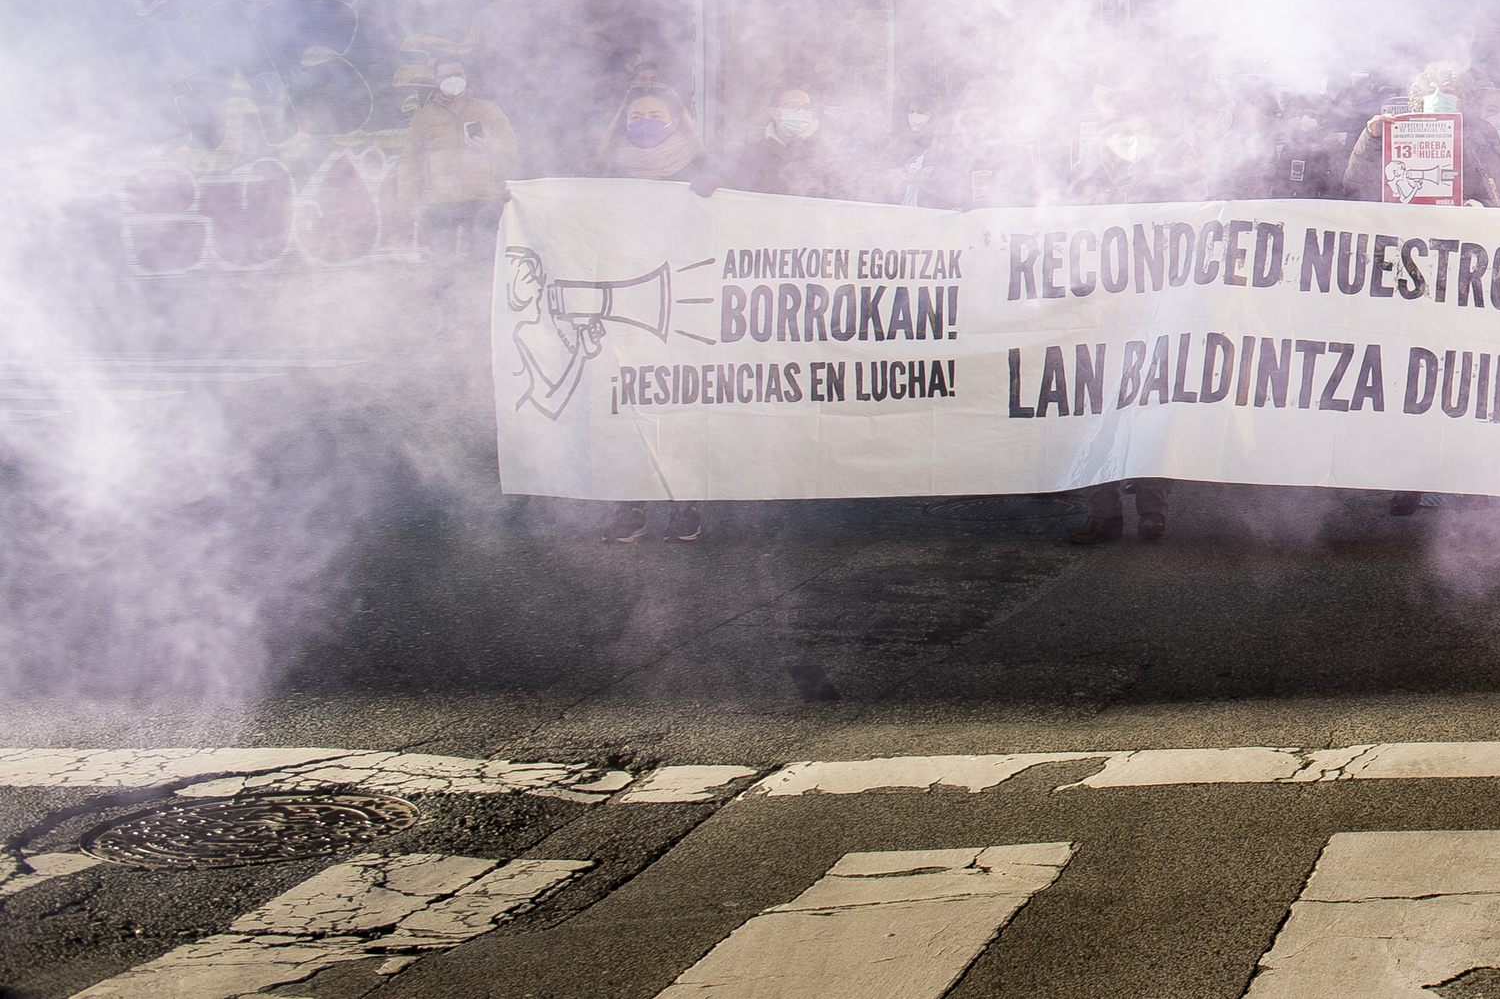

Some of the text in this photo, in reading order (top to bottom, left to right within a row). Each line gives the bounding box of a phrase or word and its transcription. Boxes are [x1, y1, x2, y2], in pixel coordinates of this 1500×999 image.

[1394, 145, 1412, 158] 13
[1420, 141, 1447, 149] GREBA
[1420, 150, 1451, 158] HUELGA
[722, 248, 963, 280] ADINEKOEN EGOITZAK
[720, 283, 959, 343] BORROKAN!
[611, 360, 956, 414] ¡RESIDENCIAS EN LUCHA!
[1008, 343, 1106, 418] LAN
[1116, 332, 1385, 412] BALDINTZA
